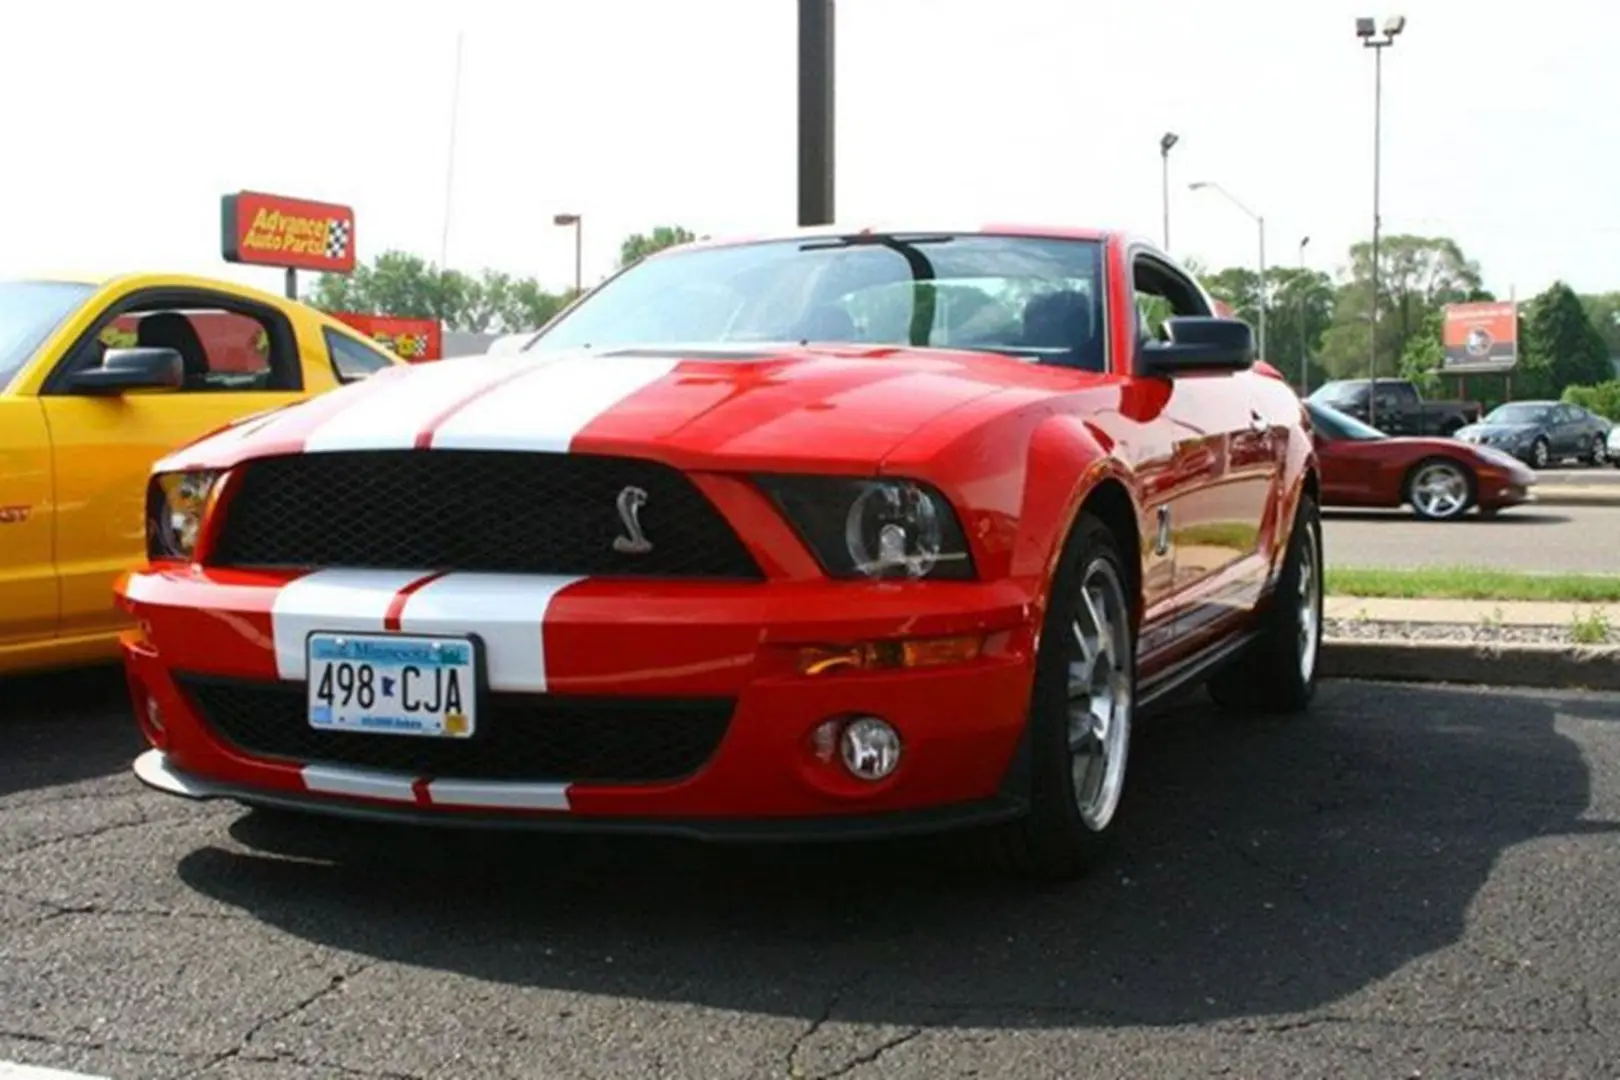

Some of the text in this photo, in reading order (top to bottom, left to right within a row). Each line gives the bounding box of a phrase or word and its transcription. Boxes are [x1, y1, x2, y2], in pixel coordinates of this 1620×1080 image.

[251, 207, 326, 240] Advance
[243, 230, 326, 255] Auto Parts
[317, 662, 462, 714] 498 CJA
